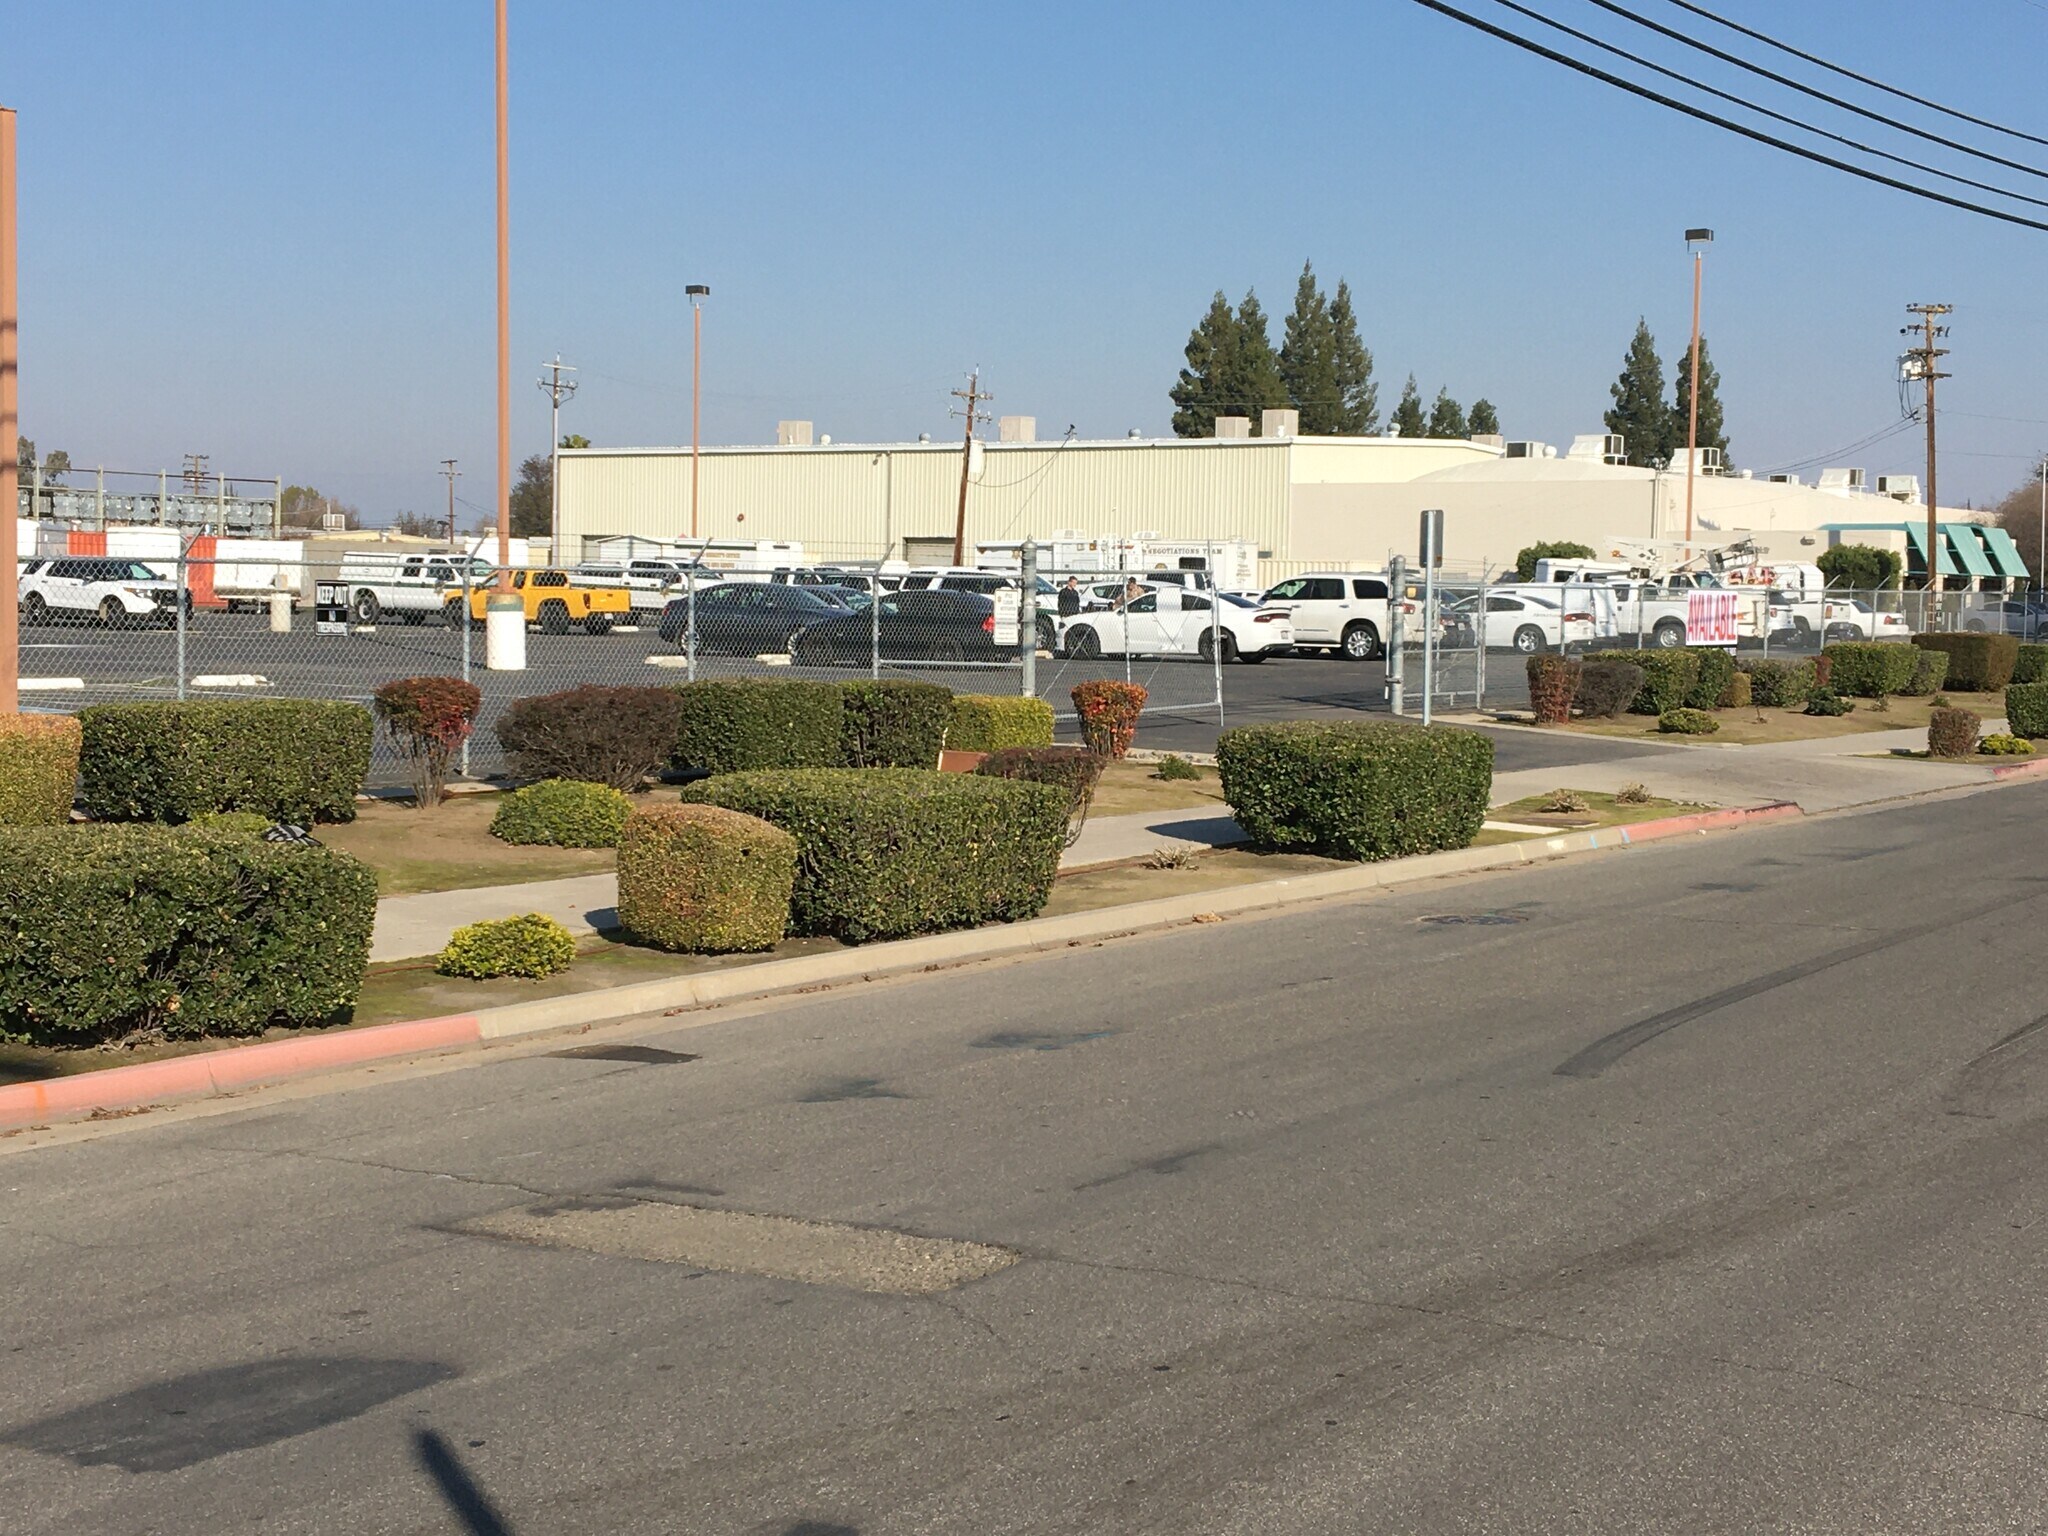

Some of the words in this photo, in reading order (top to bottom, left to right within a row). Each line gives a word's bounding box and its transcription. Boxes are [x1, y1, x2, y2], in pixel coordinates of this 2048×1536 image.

[317, 586, 334, 604] KEEP
[334, 586, 348, 604] OUT
[1687, 594, 1737, 641] AVAILABLE
